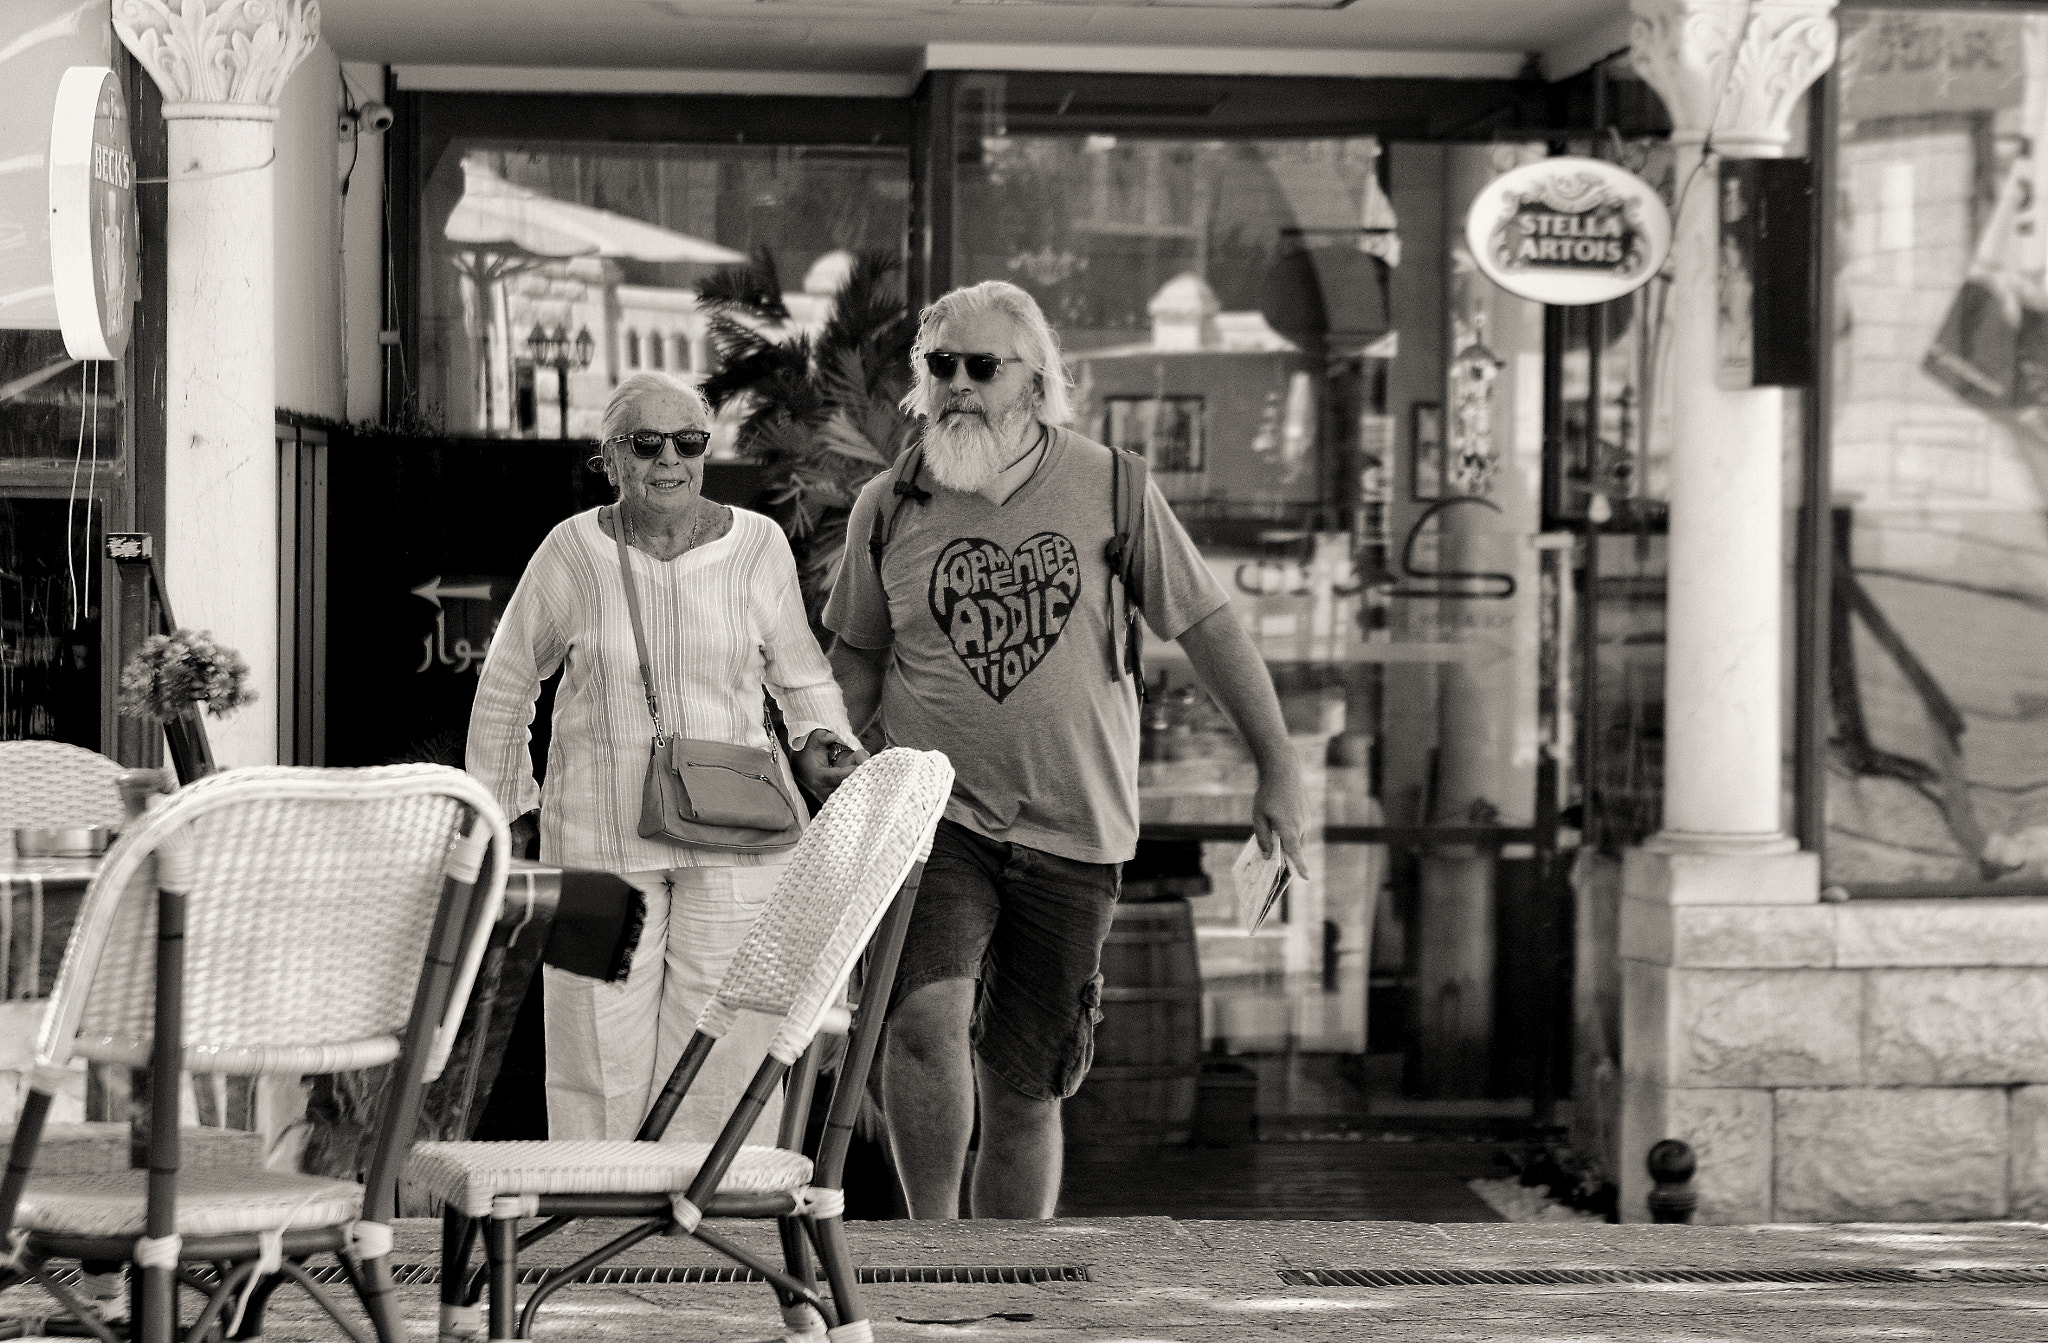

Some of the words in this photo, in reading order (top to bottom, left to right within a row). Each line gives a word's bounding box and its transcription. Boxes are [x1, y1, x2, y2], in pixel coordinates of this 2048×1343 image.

[94, 142, 131, 191] BECK'S
[1518, 212, 1622, 237] STELLA
[1518, 238, 1624, 263] ARTOIS
